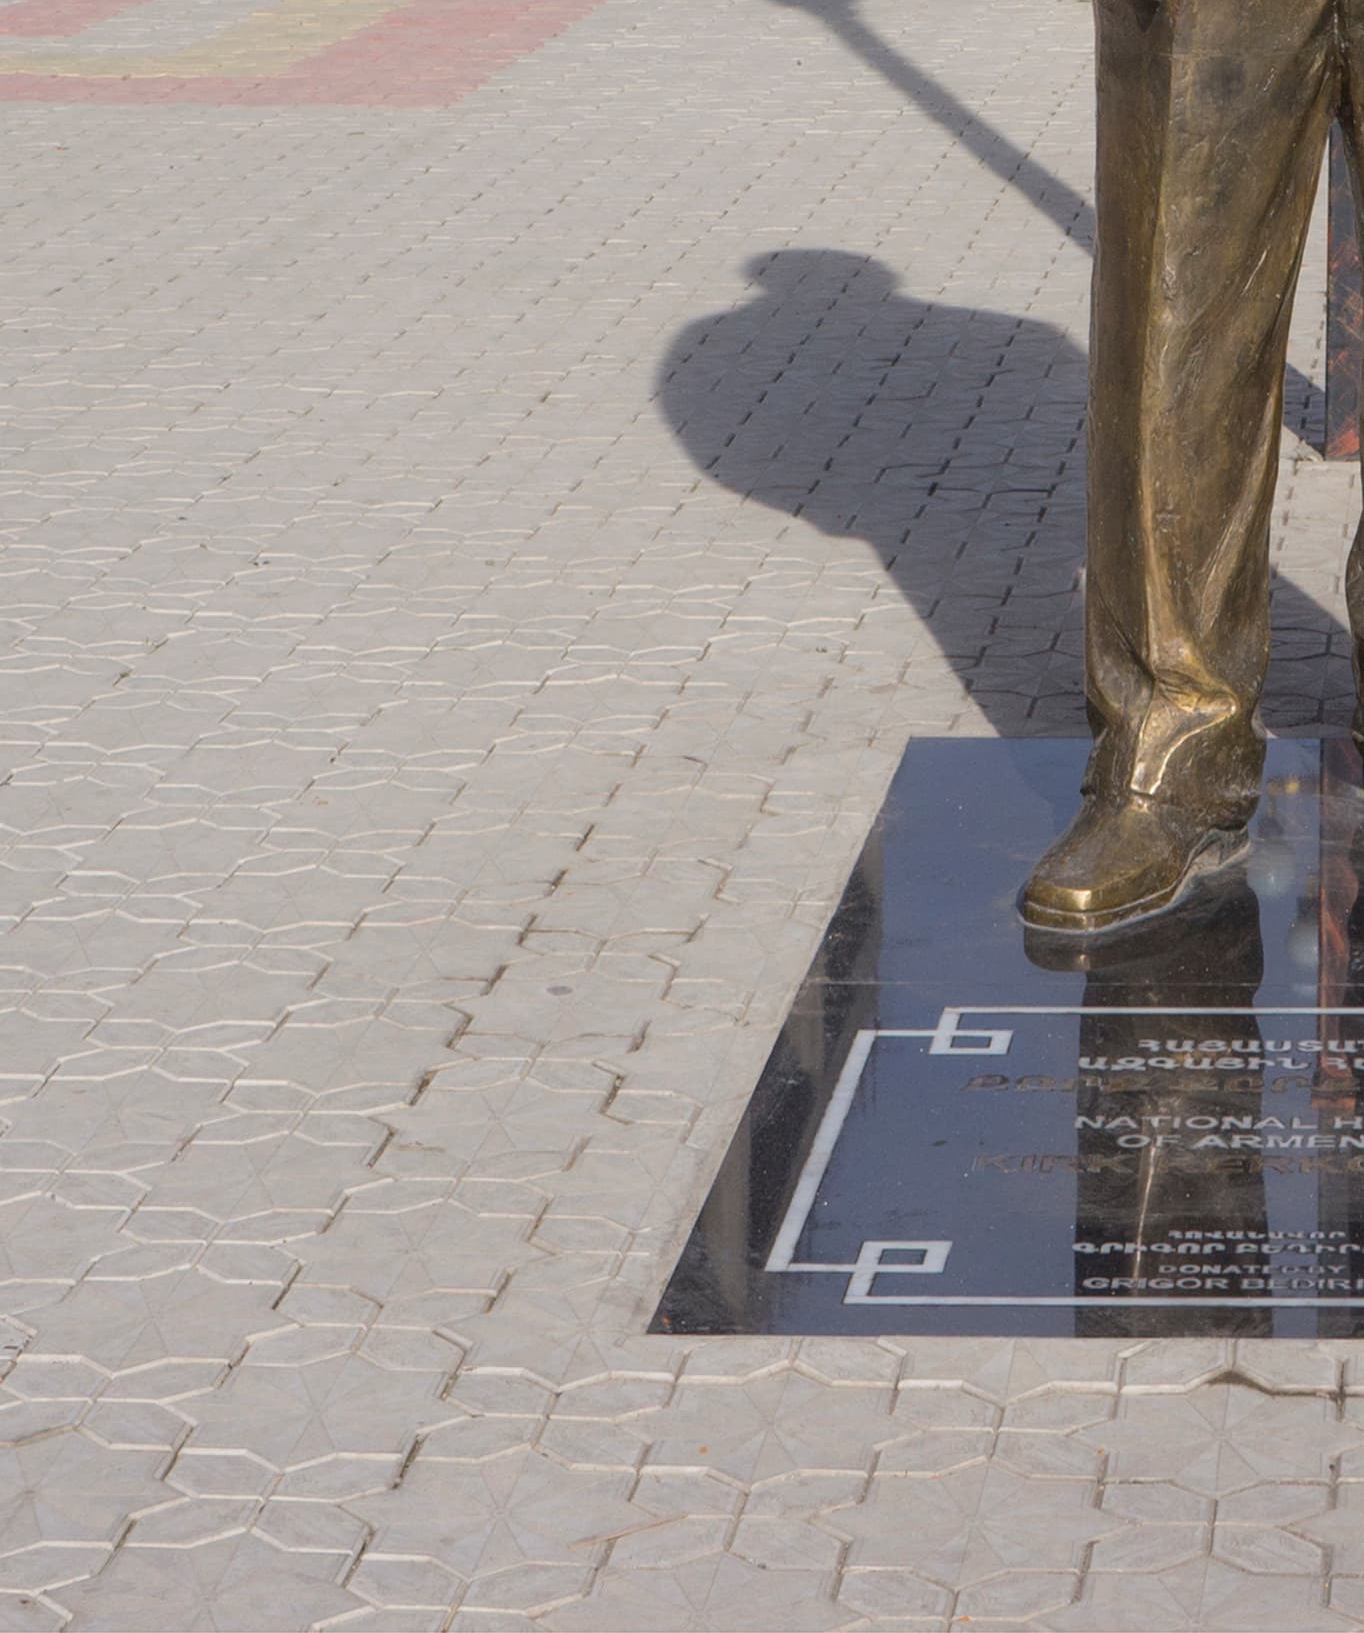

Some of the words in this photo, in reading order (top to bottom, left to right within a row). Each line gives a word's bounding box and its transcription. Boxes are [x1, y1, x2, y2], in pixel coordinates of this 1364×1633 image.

[1077, 1055, 1311, 1072] ԱԶԳԱՅԻՆ
[1074, 1115, 1315, 1130] NATIONAL
[1117, 1134, 1178, 1149] OF
[973, 1155, 1136, 1173] KIRK
[1072, 1242, 1226, 1255] ԳՐԻԳՈՐ
[1159, 1263, 1304, 1274] DONATED
[1309, 1263, 1348, 1274] BY
[1081, 1277, 1231, 1290] GRIGOR
